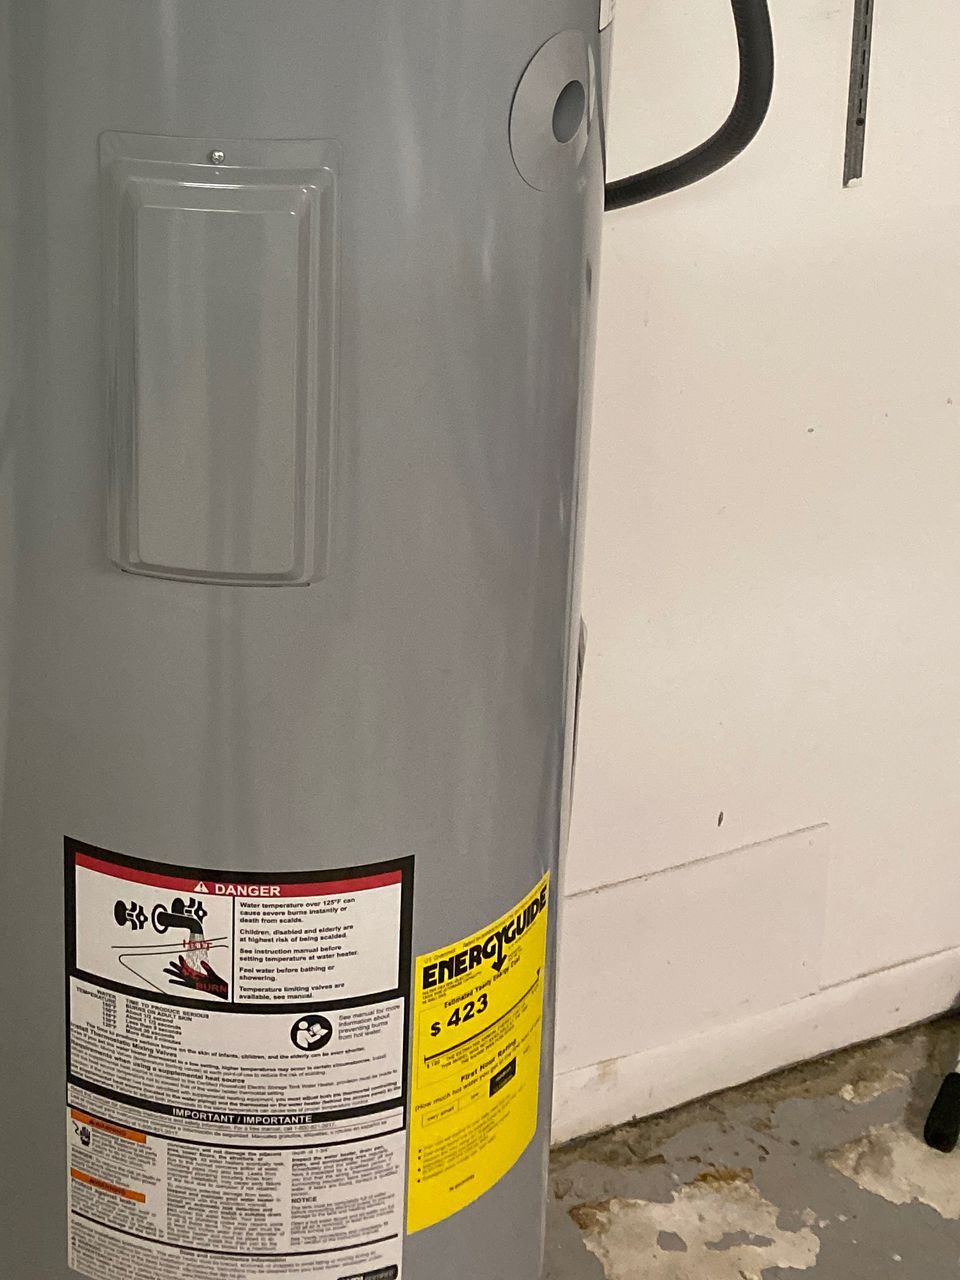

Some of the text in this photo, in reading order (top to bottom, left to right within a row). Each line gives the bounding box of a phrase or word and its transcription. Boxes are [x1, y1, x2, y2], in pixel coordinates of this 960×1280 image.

[215, 884, 281, 897] DANGER
[262, 902, 304, 910] temperature
[309, 907, 338, 915] instantly
[248, 936, 274, 944] highest
[423, 884, 547, 990] ENERGYGUIDE
[195, 982, 228, 993] BURN
[430, 993, 489, 1037] $ 423
[132, 1043, 177, 1058] Mixing Valves
[460, 1068, 478, 1082] First
[479, 1057, 496, 1072] Hour
[497, 1039, 517, 1058] Rating
[433, 1093, 451, 1105] much
[452, 1086, 463, 1095] hot
[463, 1077, 479, 1090] water
[479, 1071, 490, 1081] you
[172, 1107, 235, 1123] IMPORTANT
[243, 1115, 313, 1124] IMPORTANTE
